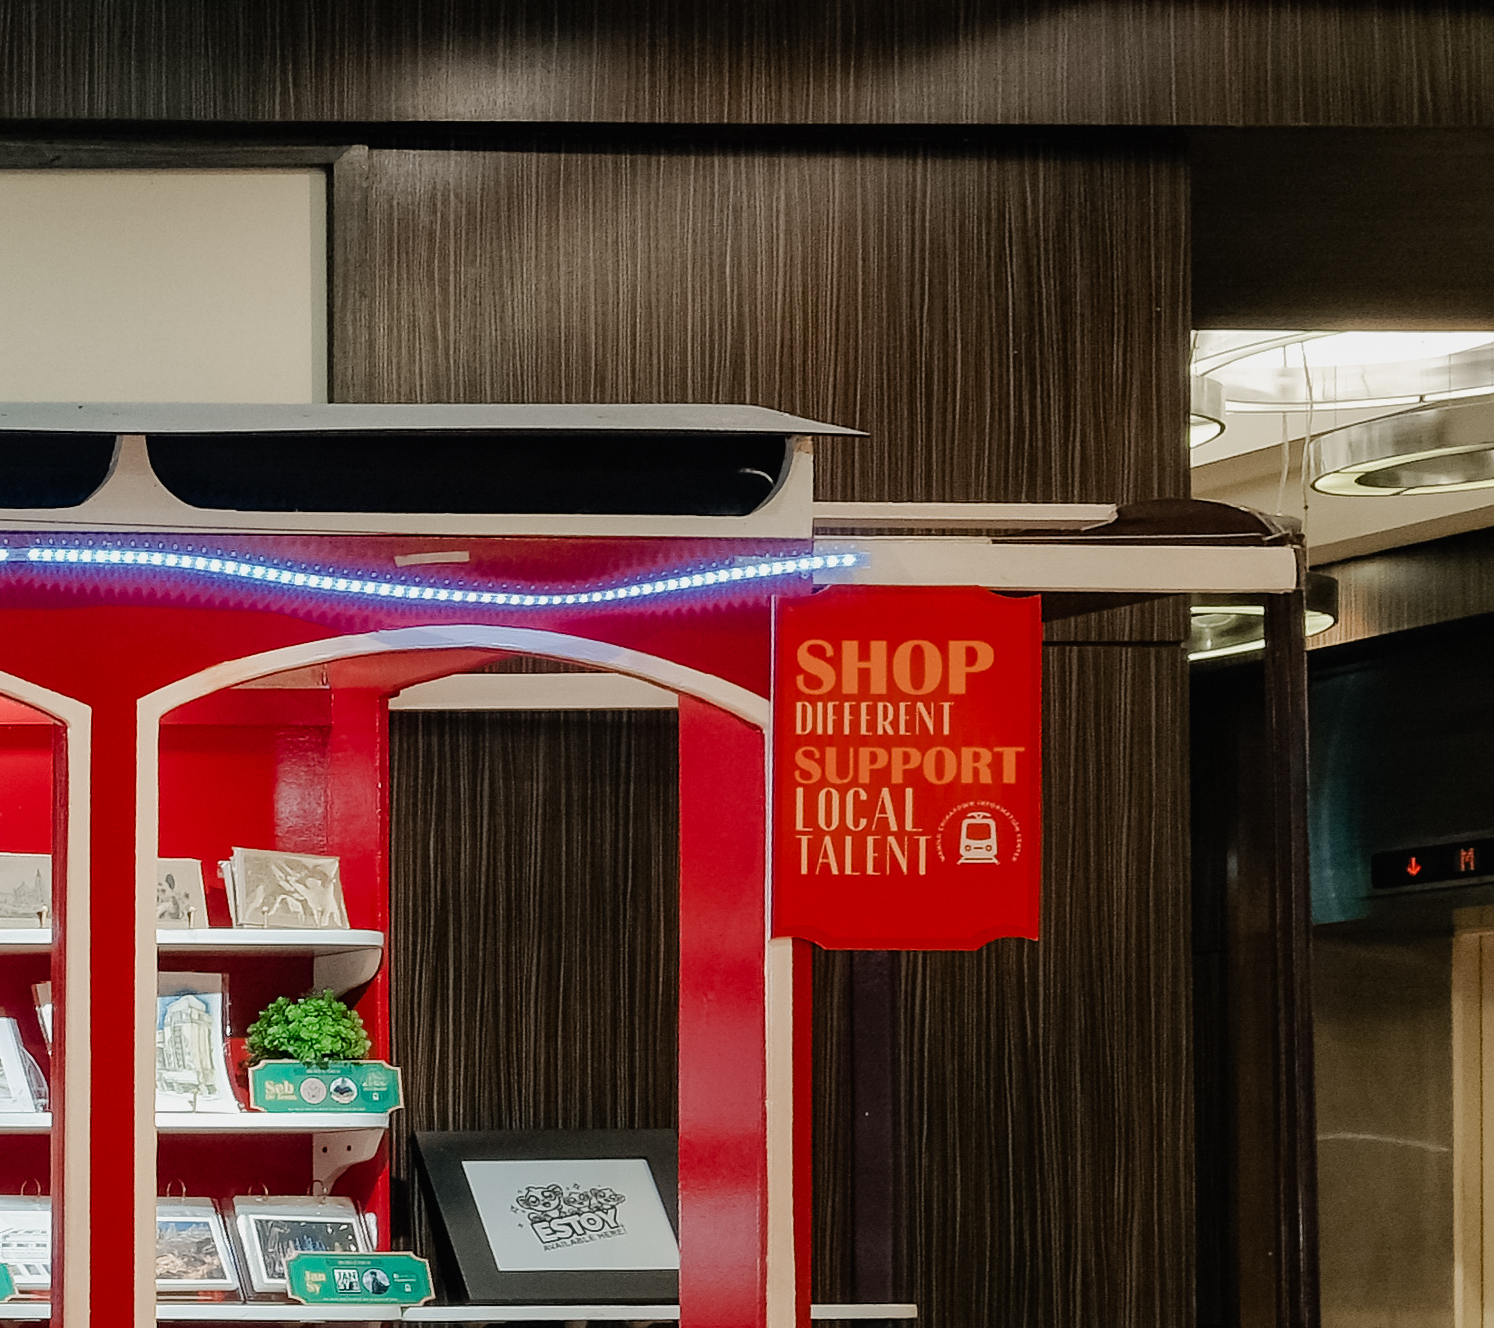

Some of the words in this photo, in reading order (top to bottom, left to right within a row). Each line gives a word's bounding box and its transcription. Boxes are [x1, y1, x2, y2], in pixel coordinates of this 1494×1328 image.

[795, 639, 995, 695] SHOP
[795, 701, 955, 736] DIFFERENT
[794, 746, 1025, 785] SUPPORT
[795, 787, 924, 832] LOCAL
[795, 835, 932, 876] TALENT
[1460, 847, 1475, 872] M
[531, 1207, 620, 1244] ESTOY
